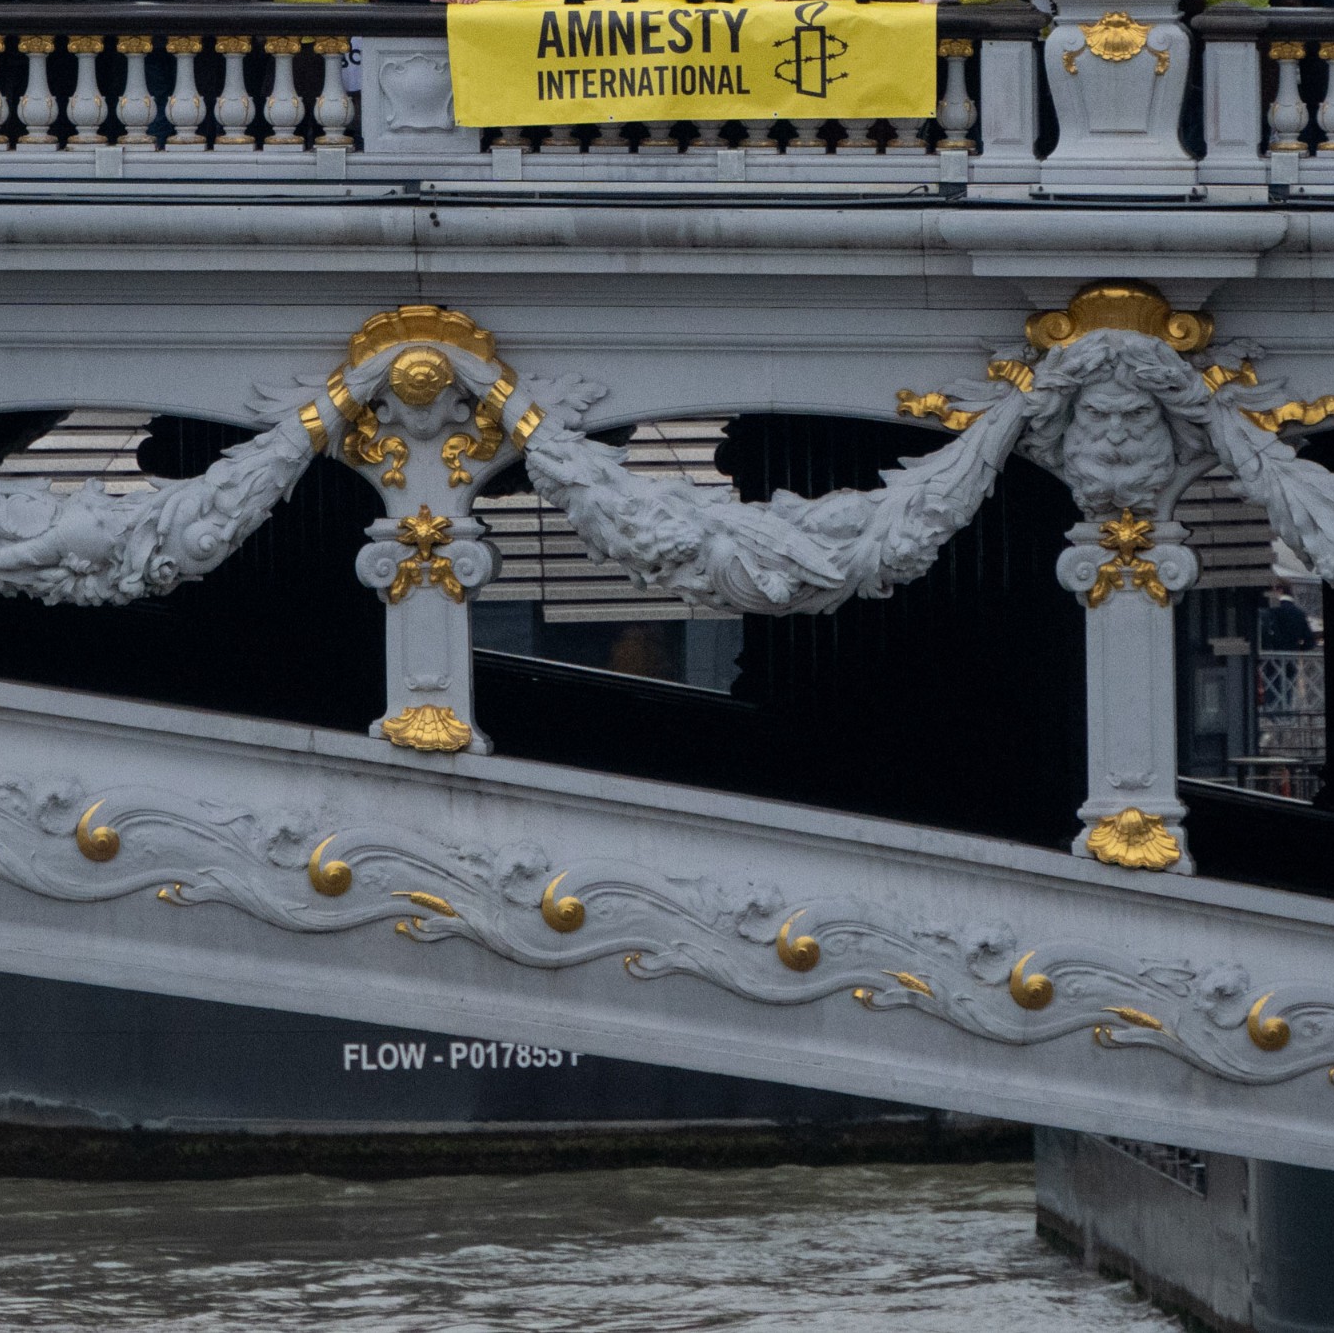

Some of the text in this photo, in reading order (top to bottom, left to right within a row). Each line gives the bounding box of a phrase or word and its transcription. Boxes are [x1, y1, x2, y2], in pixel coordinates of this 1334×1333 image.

[537, 8, 748, 58] AMNESTY
[537, 65, 750, 100] INTERNATIONAL
[343, 1043, 426, 1070] FLOW
[450, 1042, 563, 1068] P017855
